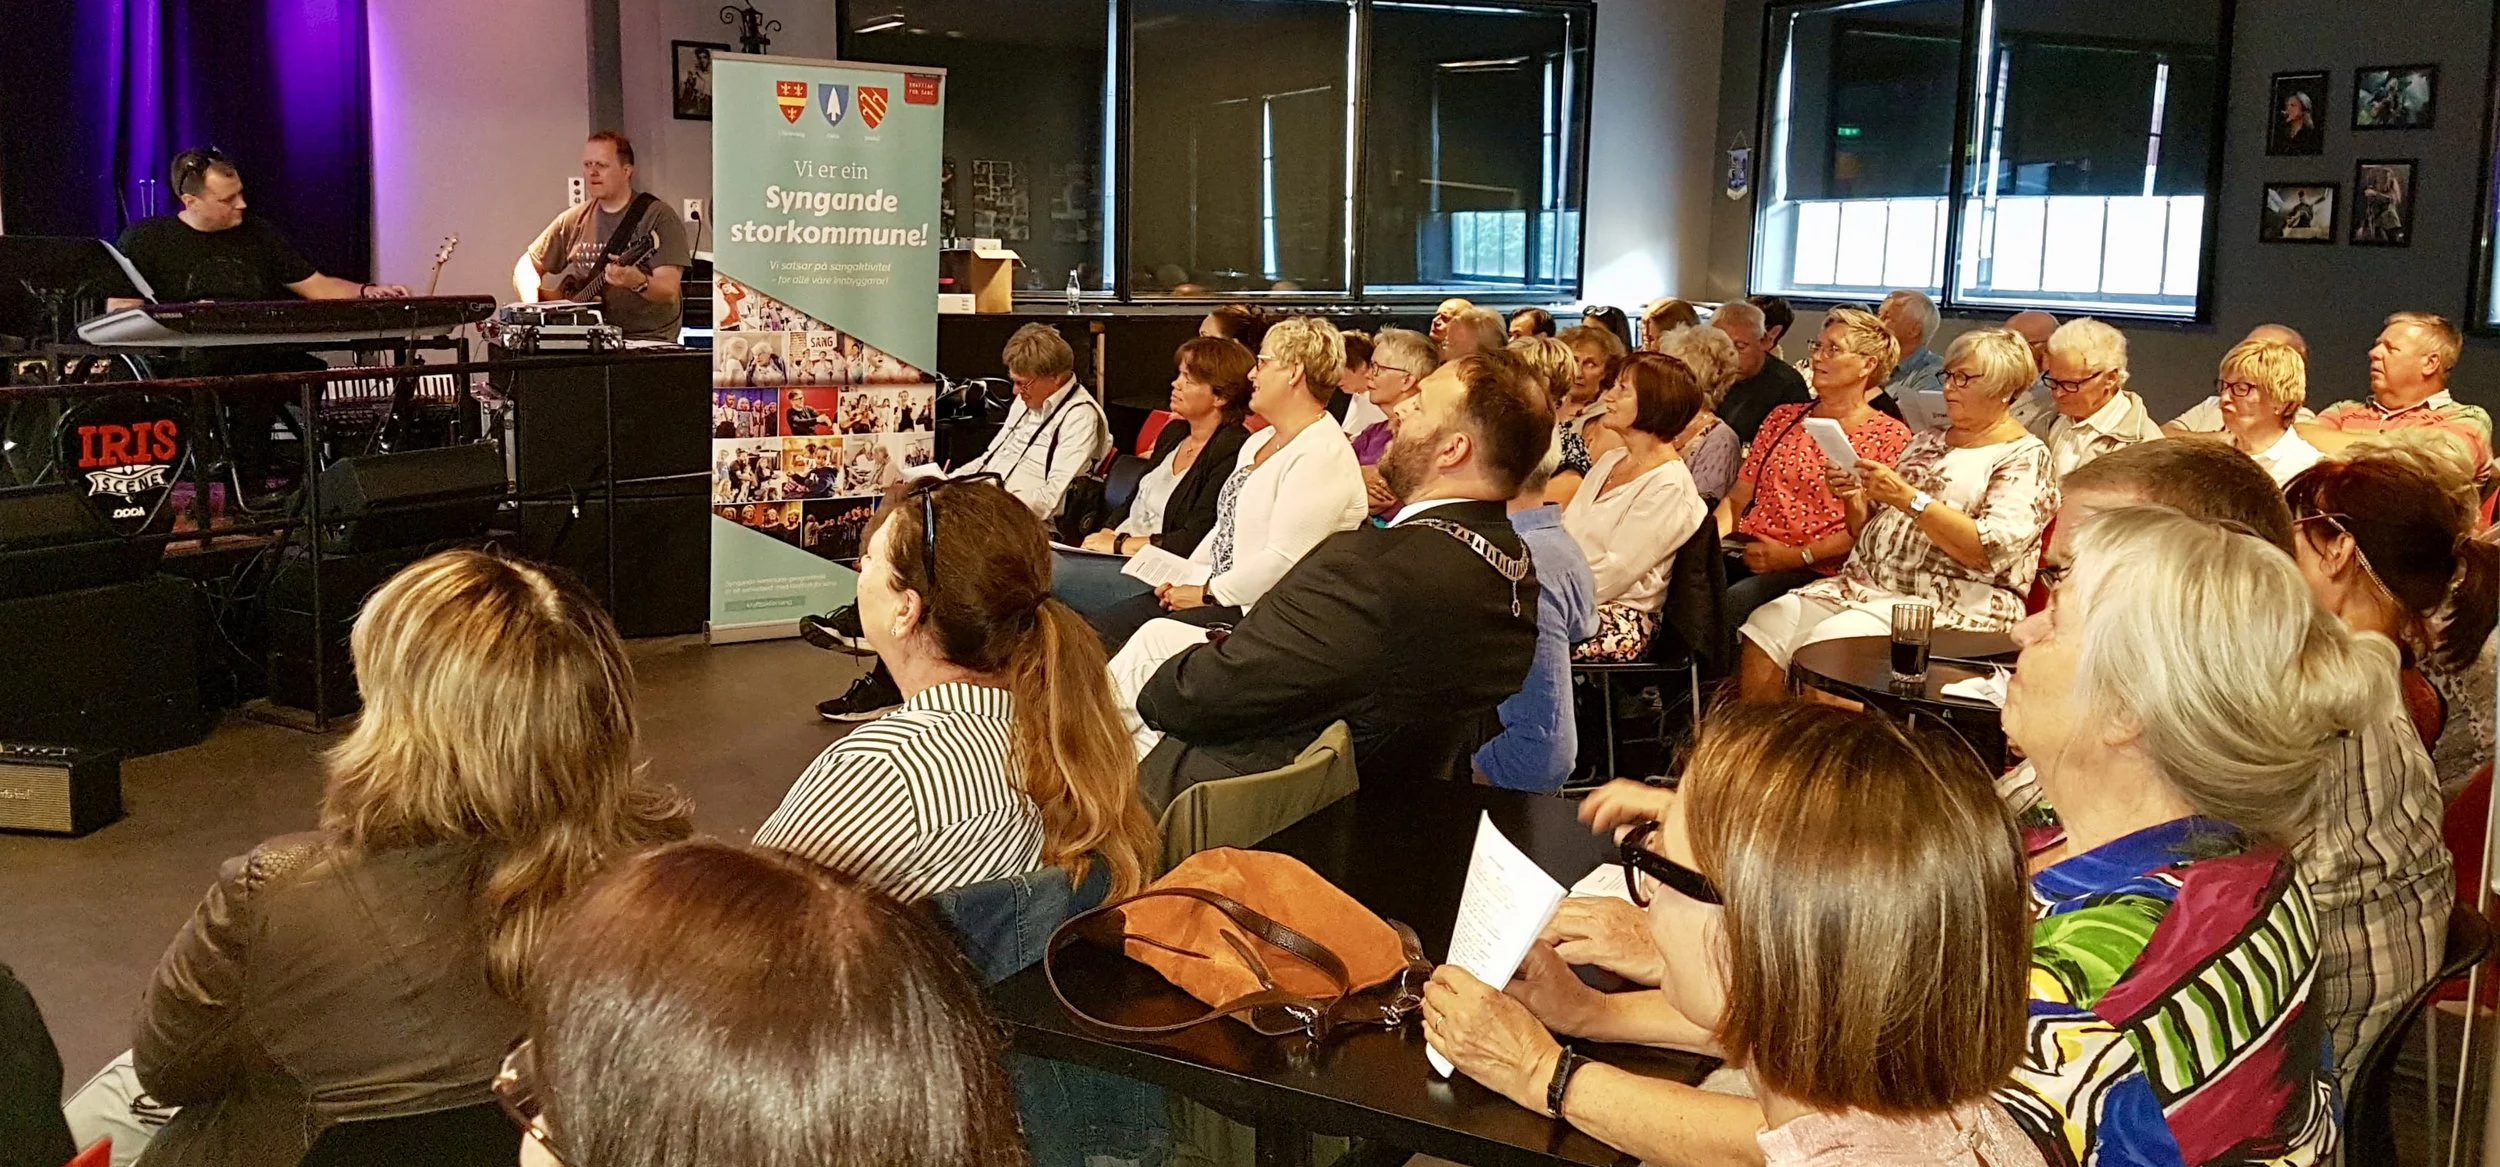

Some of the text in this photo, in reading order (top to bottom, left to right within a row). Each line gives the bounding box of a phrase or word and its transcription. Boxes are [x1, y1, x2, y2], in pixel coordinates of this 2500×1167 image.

[794, 160, 868, 179] Vi er ein
[765, 185, 898, 216] Syngande
[731, 219, 929, 246] storkommune!
[769, 260, 779, 270] Vi
[781, 261, 813, 271] satsar
[813, 262, 828, 273] på
[777, 275, 791, 285] for
[792, 276, 809, 285] alle
[810, 336, 834, 348] SANG
[78, 420, 177, 467] IRIS
[103, 474, 160, 493] SCENE
